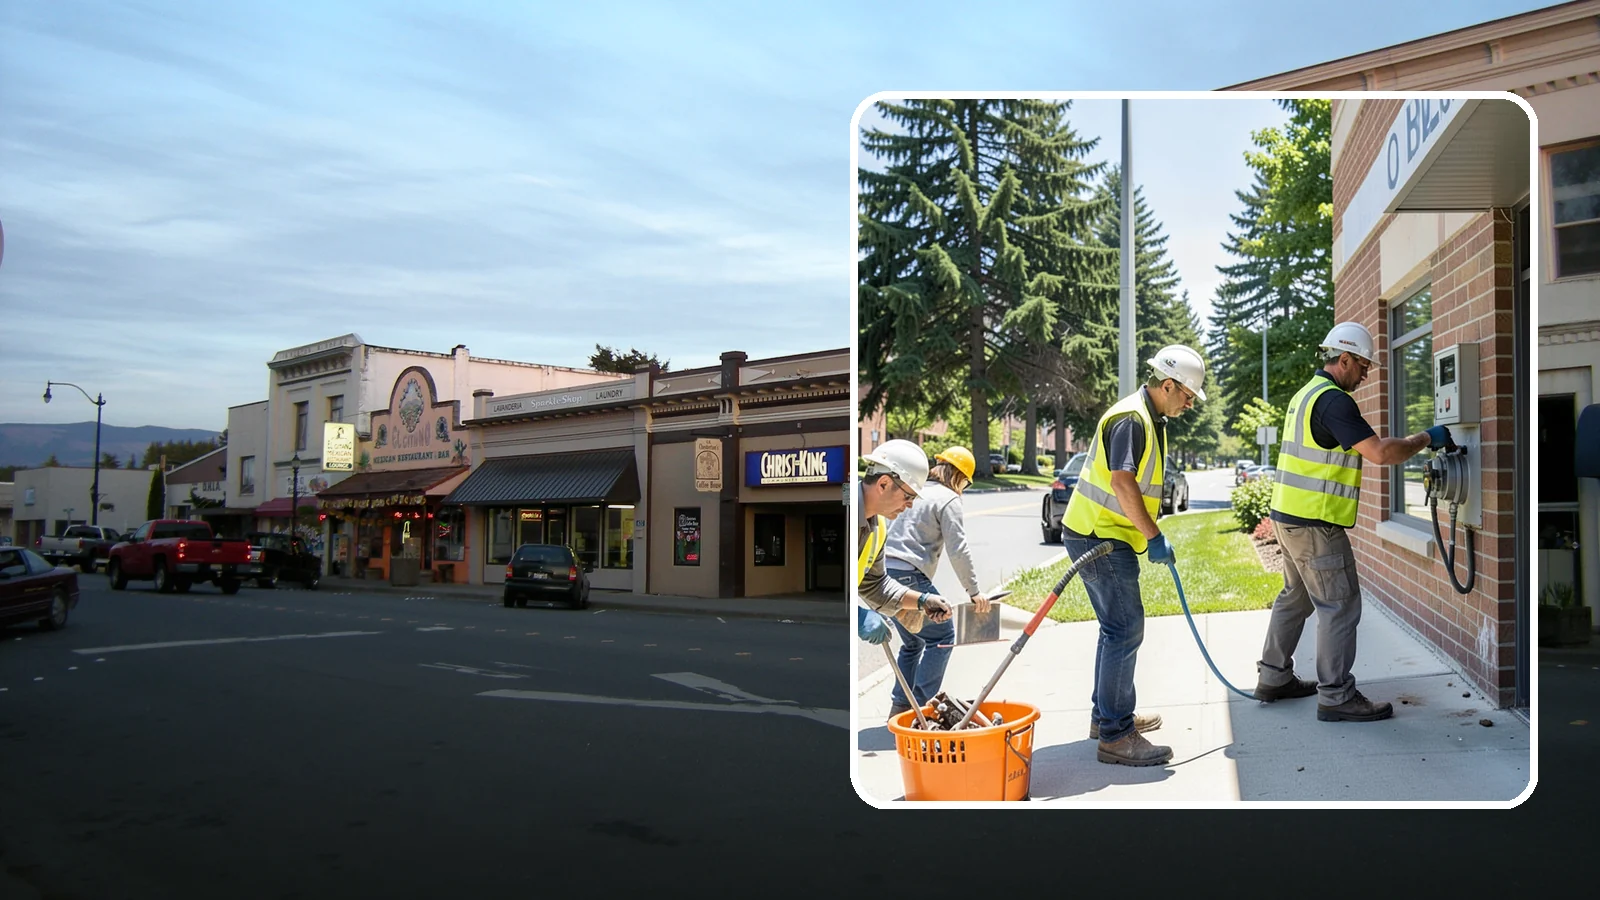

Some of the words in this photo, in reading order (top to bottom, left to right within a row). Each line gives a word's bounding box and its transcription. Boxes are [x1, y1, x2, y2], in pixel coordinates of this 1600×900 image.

[493, 402, 523, 413] LAVANDERIA
[562, 394, 583, 404] Shop
[595, 389, 624, 400] LAUNDRY
[373, 455, 396, 464] MEXICAN
[397, 452, 434, 462] RESTAURANT
[438, 450, 450, 459] BAR
[760, 452, 797, 478] CHRIST
[799, 450, 827, 476] KING
